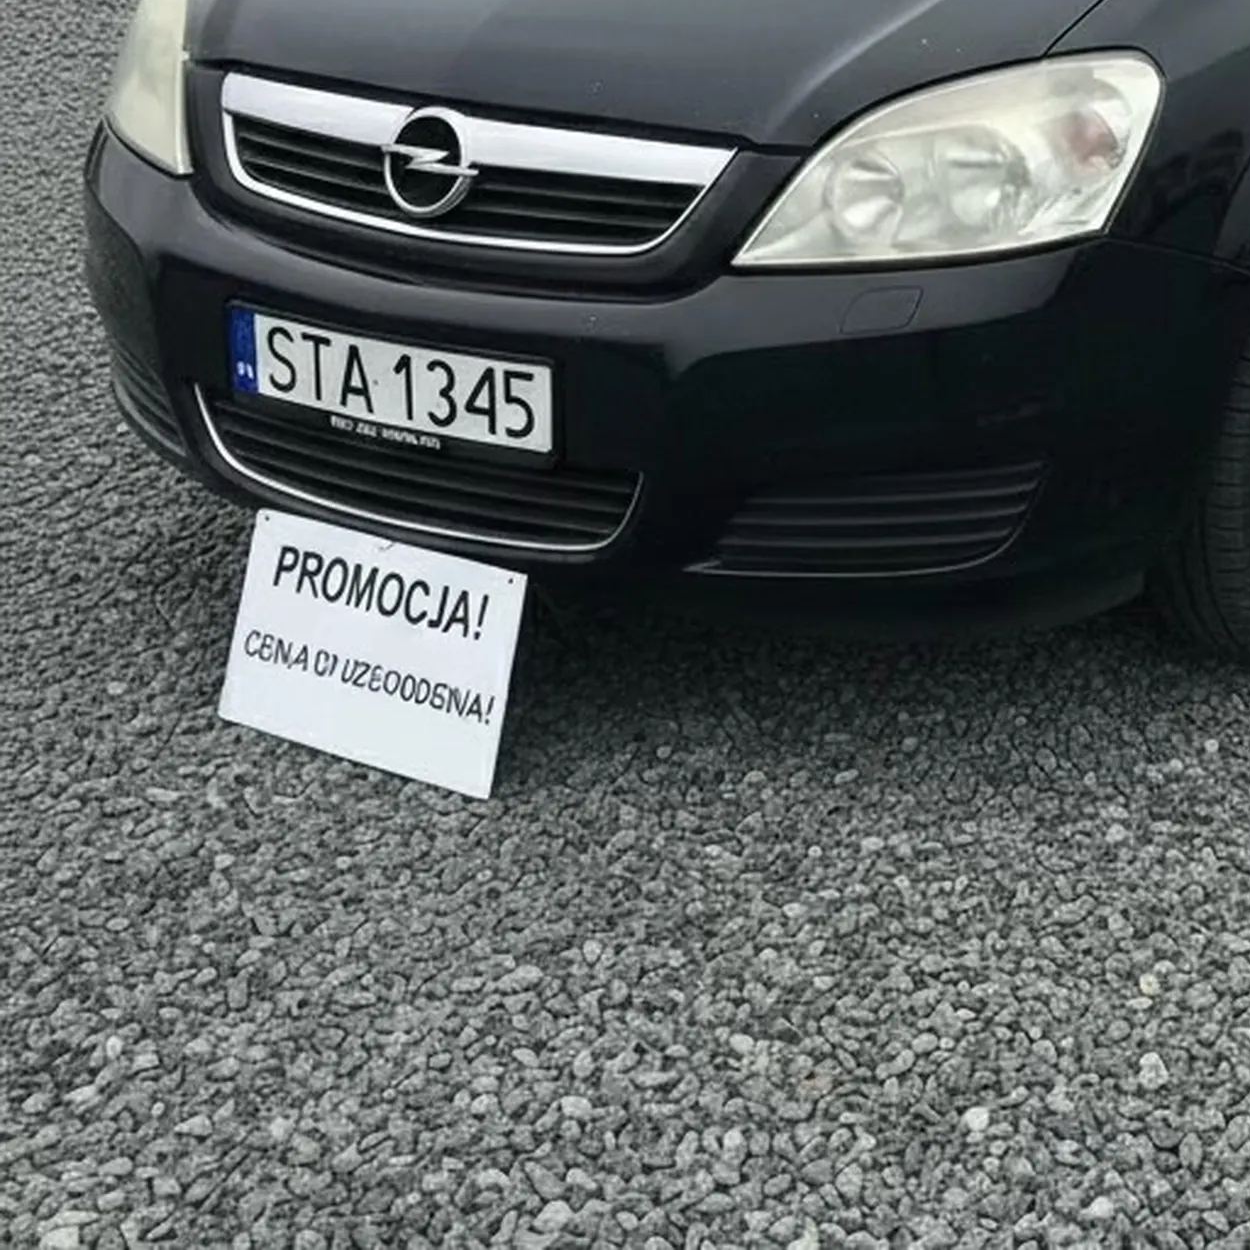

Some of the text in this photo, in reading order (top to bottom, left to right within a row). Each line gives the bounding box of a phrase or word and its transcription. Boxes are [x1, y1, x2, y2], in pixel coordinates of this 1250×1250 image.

[266, 326, 374, 413] STA
[392, 353, 536, 439] 1345
[272, 545, 489, 641] PROMOCJA!
